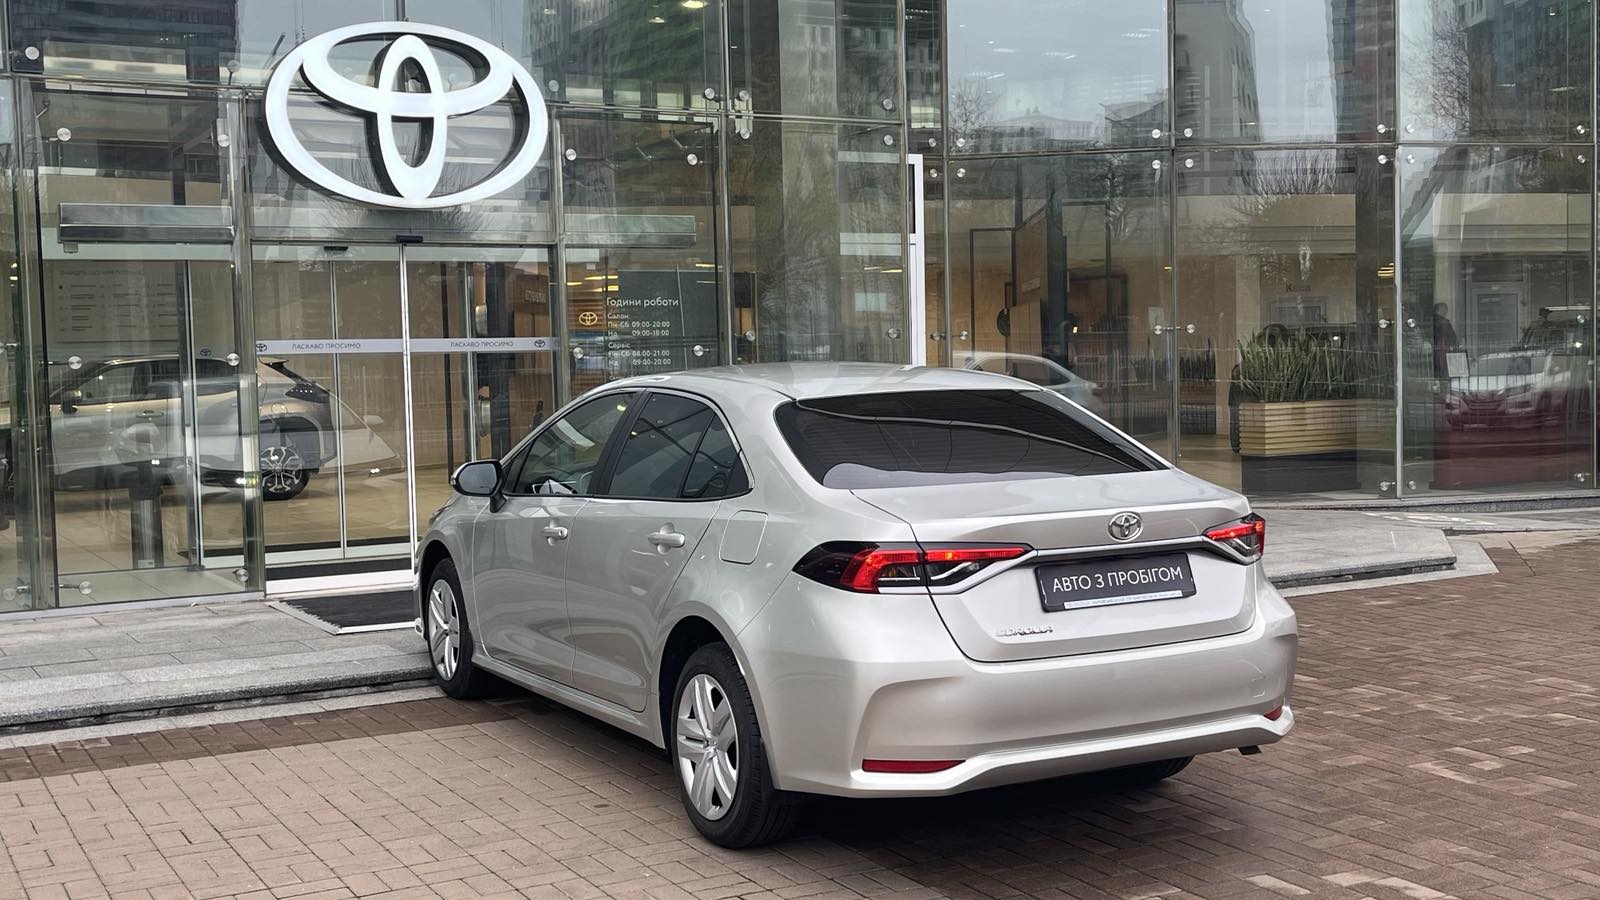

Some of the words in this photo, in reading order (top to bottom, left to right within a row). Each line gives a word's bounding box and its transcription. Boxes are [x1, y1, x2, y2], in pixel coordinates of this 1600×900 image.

[606, 297, 641, 307] Години
[643, 297, 679, 308] роботи
[1052, 574, 1092, 593] АВТО
[1107, 565, 1184, 587] ПРОБІГОМ
